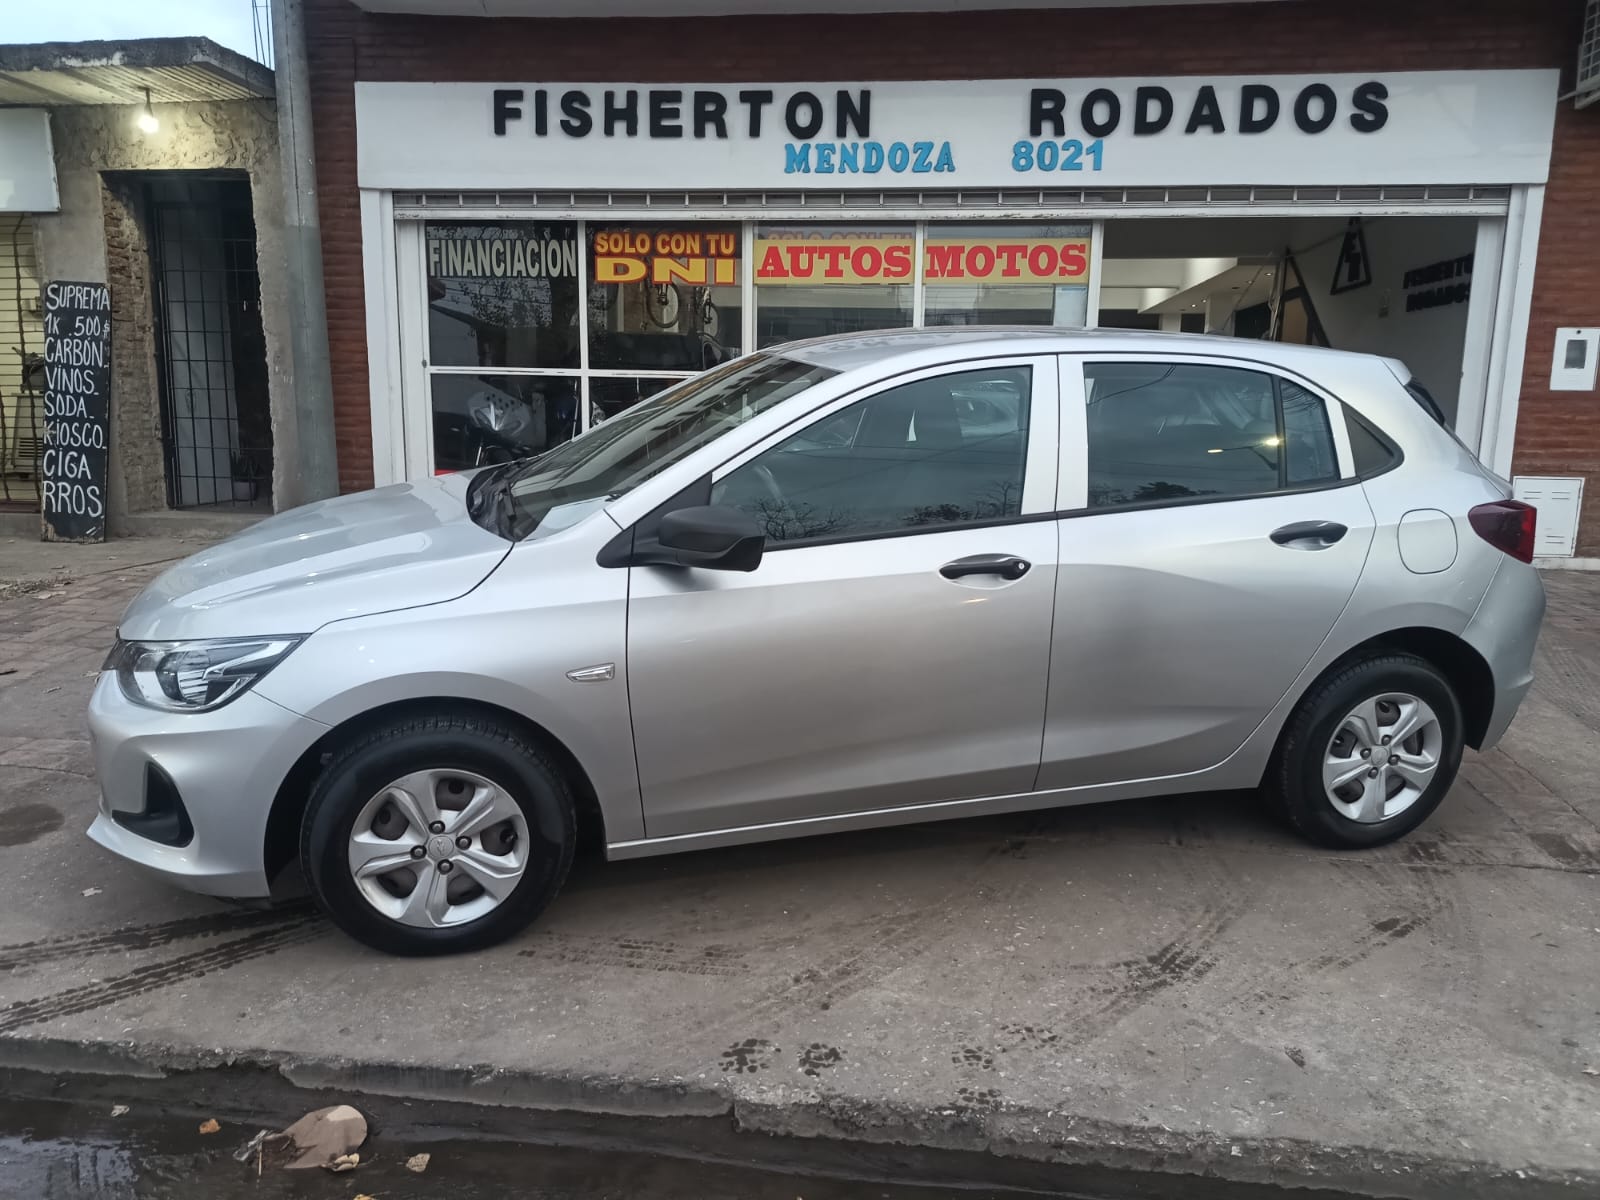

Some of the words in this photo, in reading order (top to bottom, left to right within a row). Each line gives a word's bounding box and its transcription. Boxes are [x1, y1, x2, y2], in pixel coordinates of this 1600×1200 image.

[493, 88, 872, 140] FISHERTON
[1029, 81, 1389, 139] RODADOS
[784, 141, 955, 173] MENDOZA
[1011, 139, 1104, 172] 8021
[428, 239, 577, 278] FINANCIACION
[595, 232, 651, 255] SOLO
[656, 233, 700, 255] CON
[705, 233, 736, 255] TU
[595, 256, 736, 285] DNI
[757, 246, 912, 278] AUTOS
[925, 244, 1087, 278] MOTOS
[46, 284, 110, 310] SUPREMA
